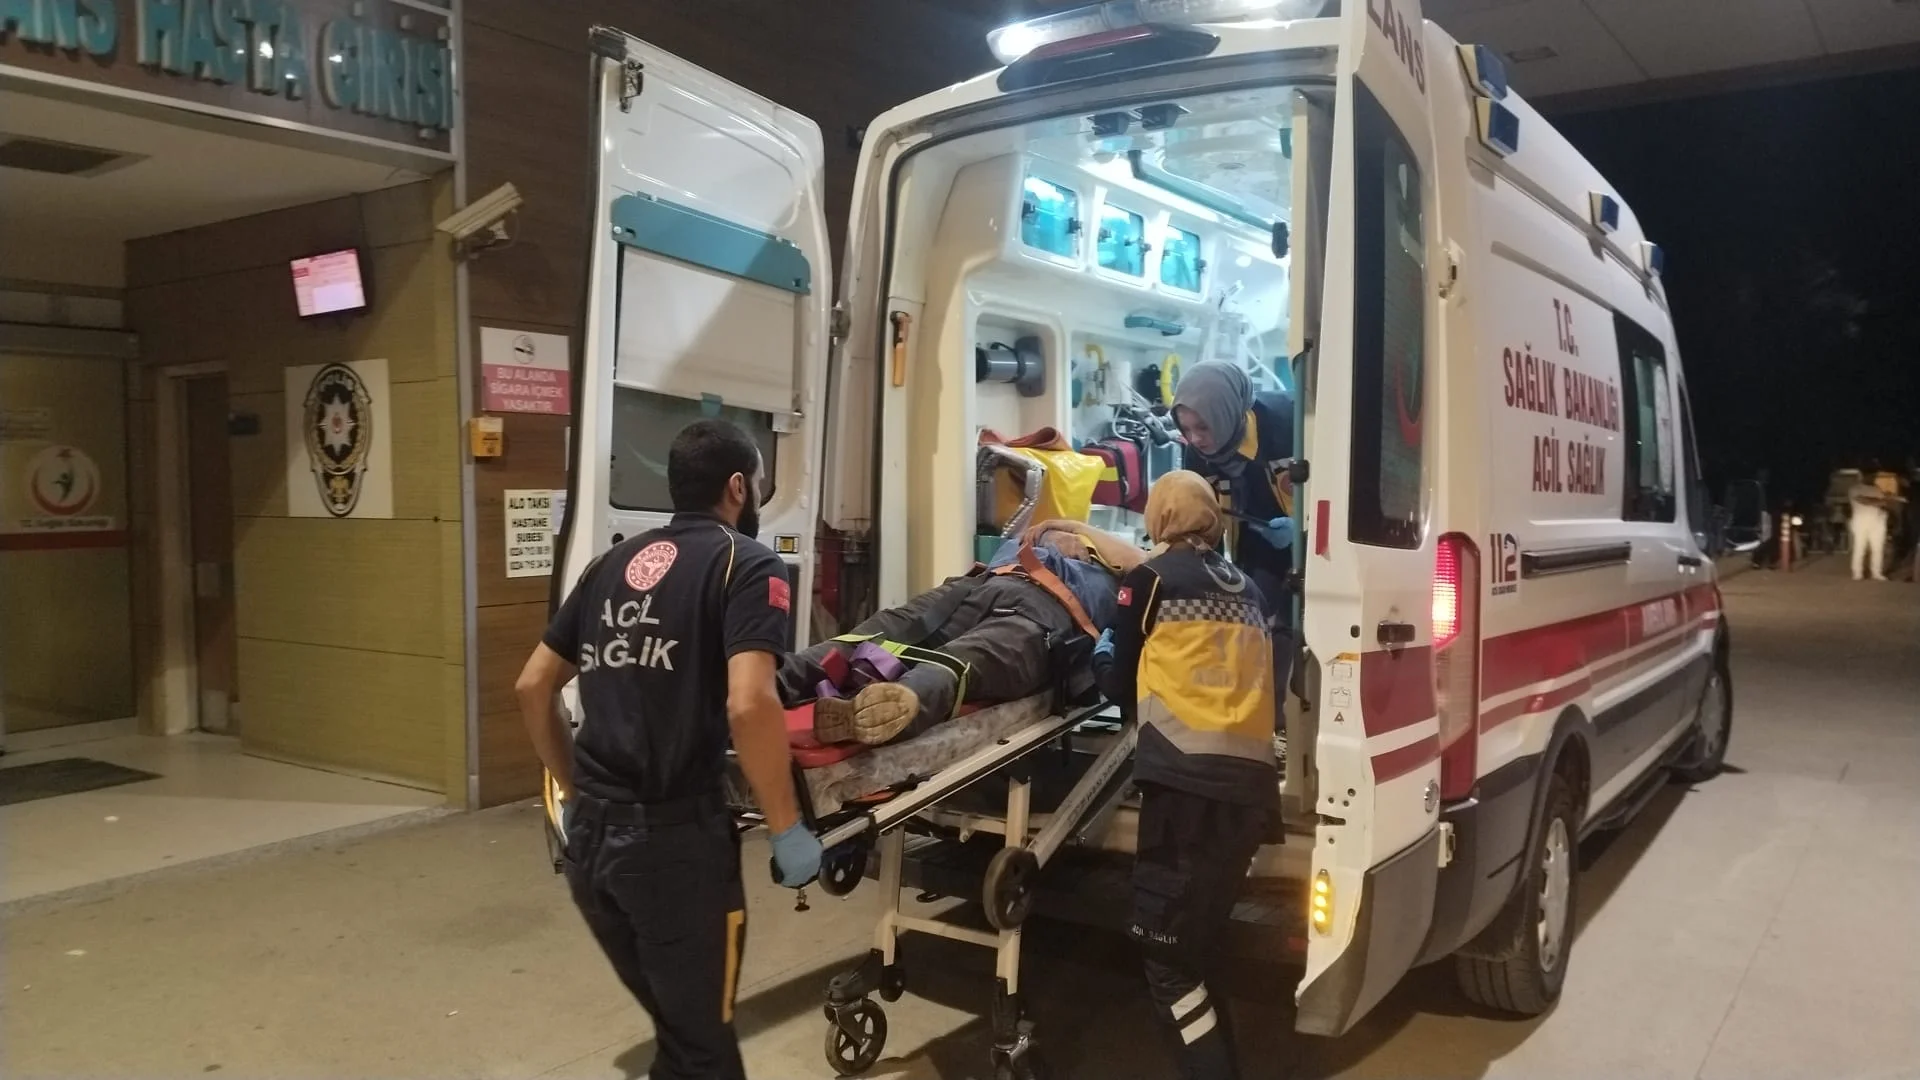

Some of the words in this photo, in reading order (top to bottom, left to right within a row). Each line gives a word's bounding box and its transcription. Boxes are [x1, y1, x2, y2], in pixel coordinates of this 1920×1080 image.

[136, 0, 302, 99] HASTA
[1553, 298, 1579, 357] T.C.
[1503, 341, 1558, 416] SAĞLIK
[1532, 428, 1562, 493] ACİL
[1567, 435, 1606, 495] SAĞLIK
[1490, 532, 1518, 584] 112
